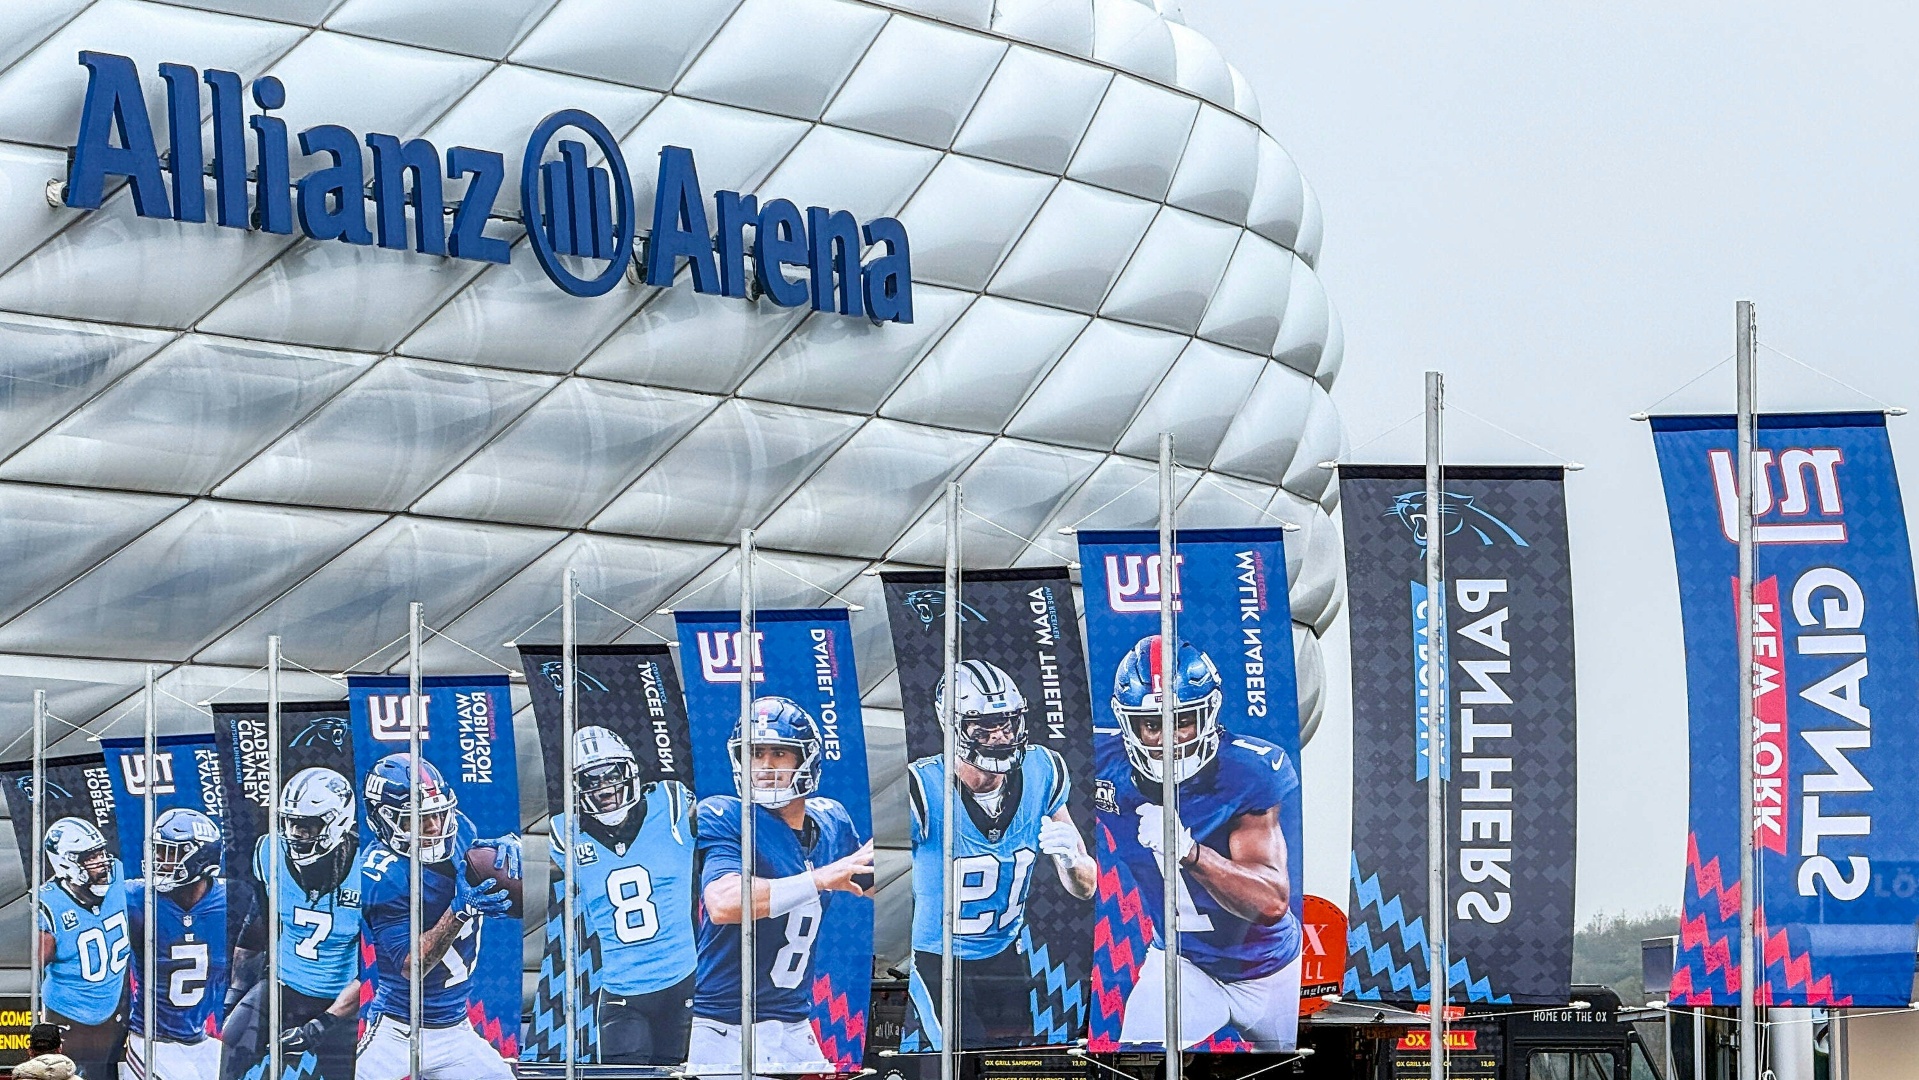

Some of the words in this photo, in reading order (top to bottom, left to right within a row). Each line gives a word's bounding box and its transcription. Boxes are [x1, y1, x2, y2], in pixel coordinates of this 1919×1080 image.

[67, 50, 512, 264] Allianz
[646, 145, 914, 324] Arena
[237, 719, 260, 803] CLOWNEY
[251, 720, 270, 807] JADEVEON
[293, 905, 334, 961] 7
[1302, 924, 1329, 956] X
[1300, 984, 1338, 997] inglers
[0, 1010, 32, 1026] COME
[1533, 1011, 1558, 1022] HOME
[1561, 1011, 1573, 1022] OF
[1575, 1011, 1593, 1022] THE
[1595, 1011, 1607, 1022] OX
[1405, 1033, 1427, 1047] OX
[1442, 1033, 1469, 1047] RILL
